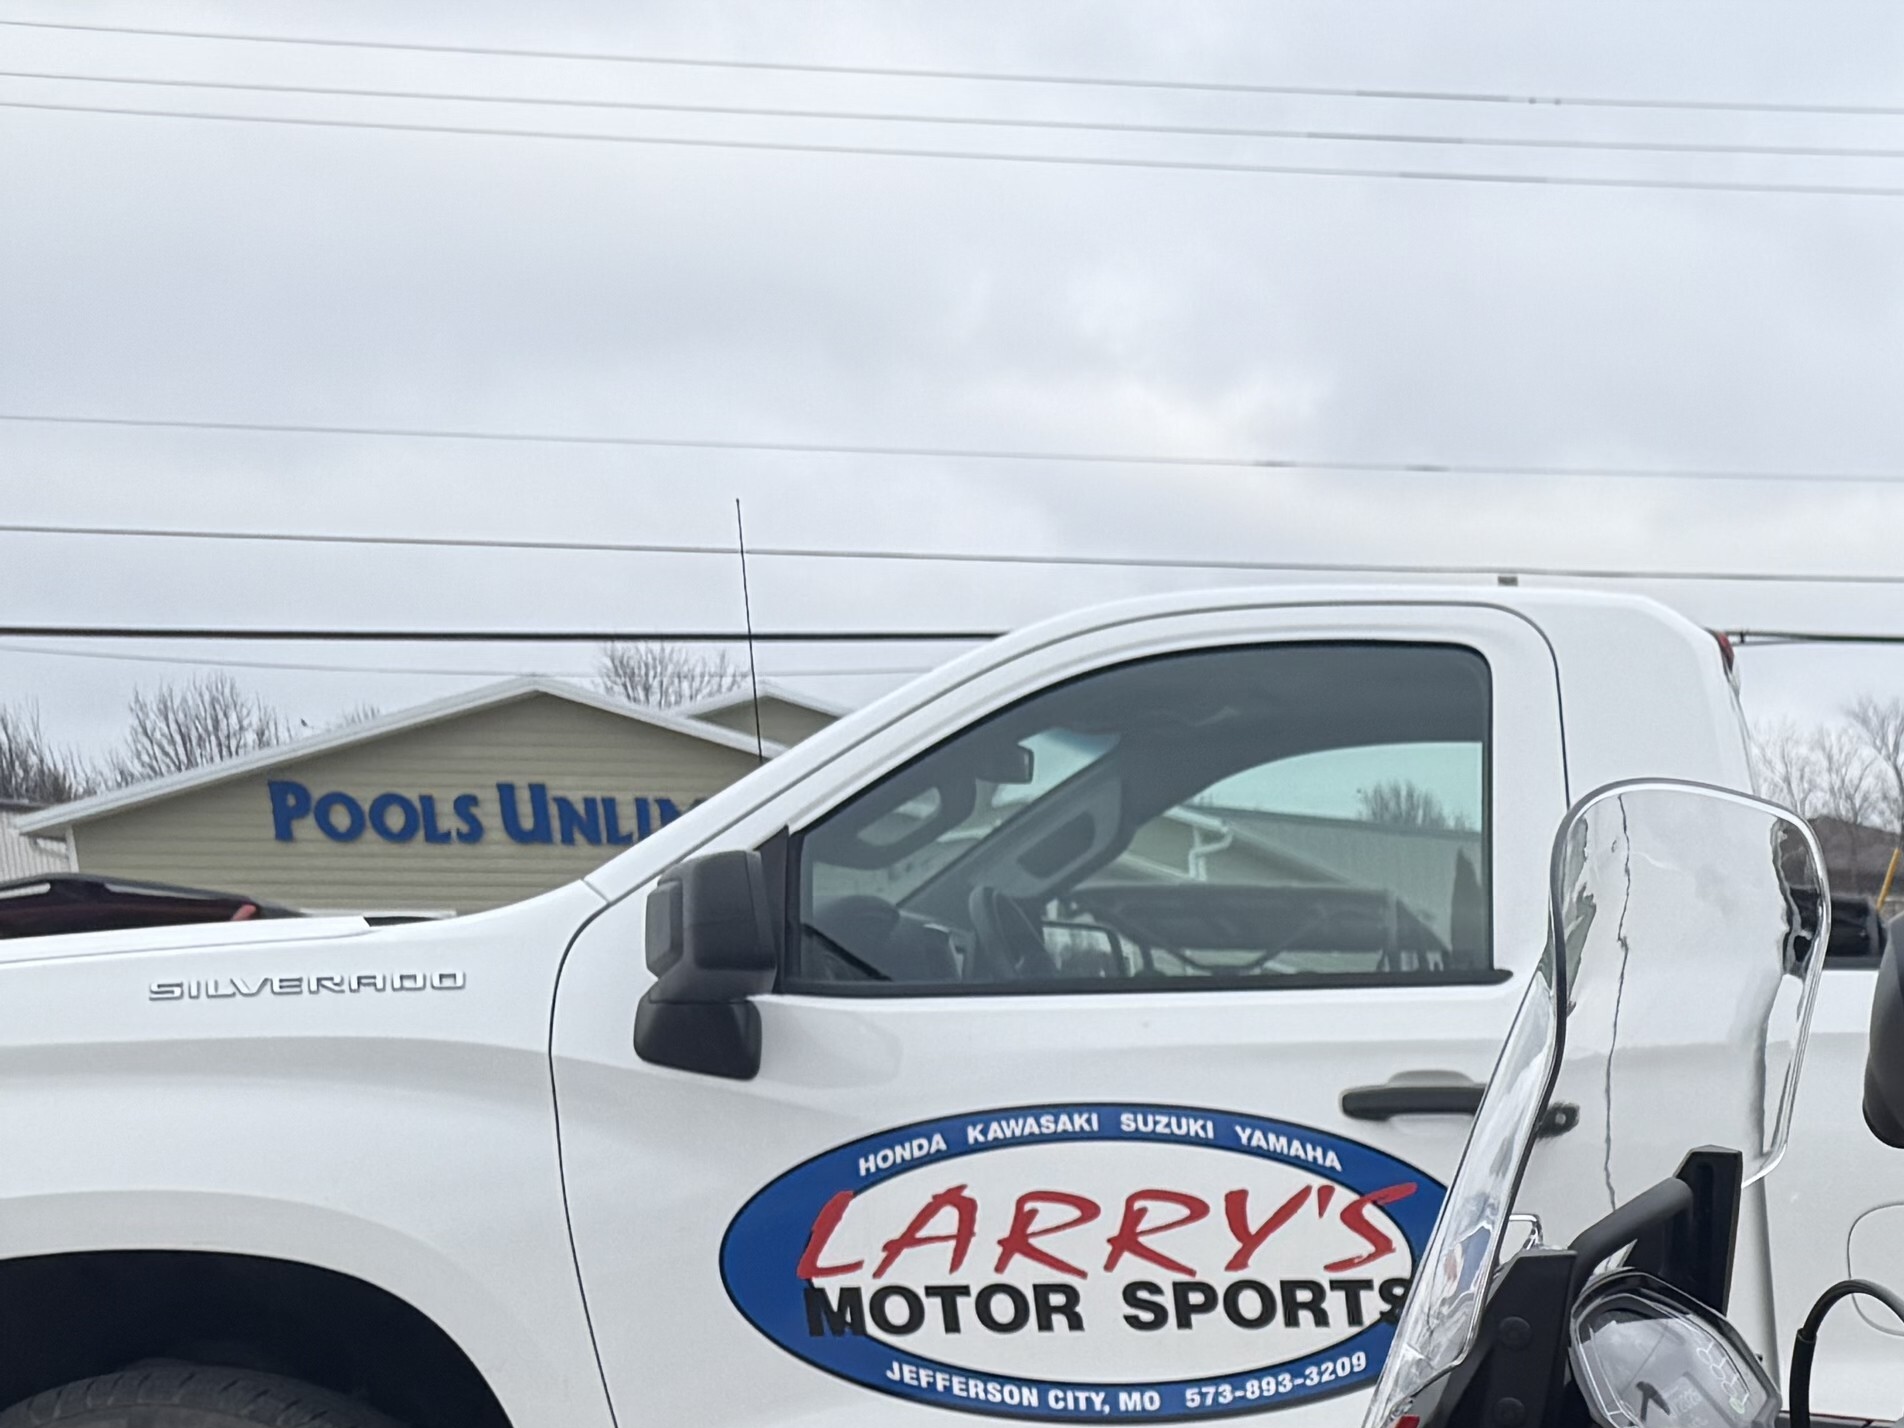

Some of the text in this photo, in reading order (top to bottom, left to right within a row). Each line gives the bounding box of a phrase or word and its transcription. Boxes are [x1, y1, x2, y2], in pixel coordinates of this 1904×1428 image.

[267, 780, 484, 844] POOLS
[149, 970, 466, 1001] SILVERADO
[858, 1113, 1343, 1176] HONDA KAWASAKI SUZUKI YAMAHA
[796, 1182, 1418, 1280] LARRY'S
[803, 1277, 1412, 1338] MOTOR SPORTS
[886, 1351, 1368, 1415] JEFFERSON CITY, MO 573-893-3209
